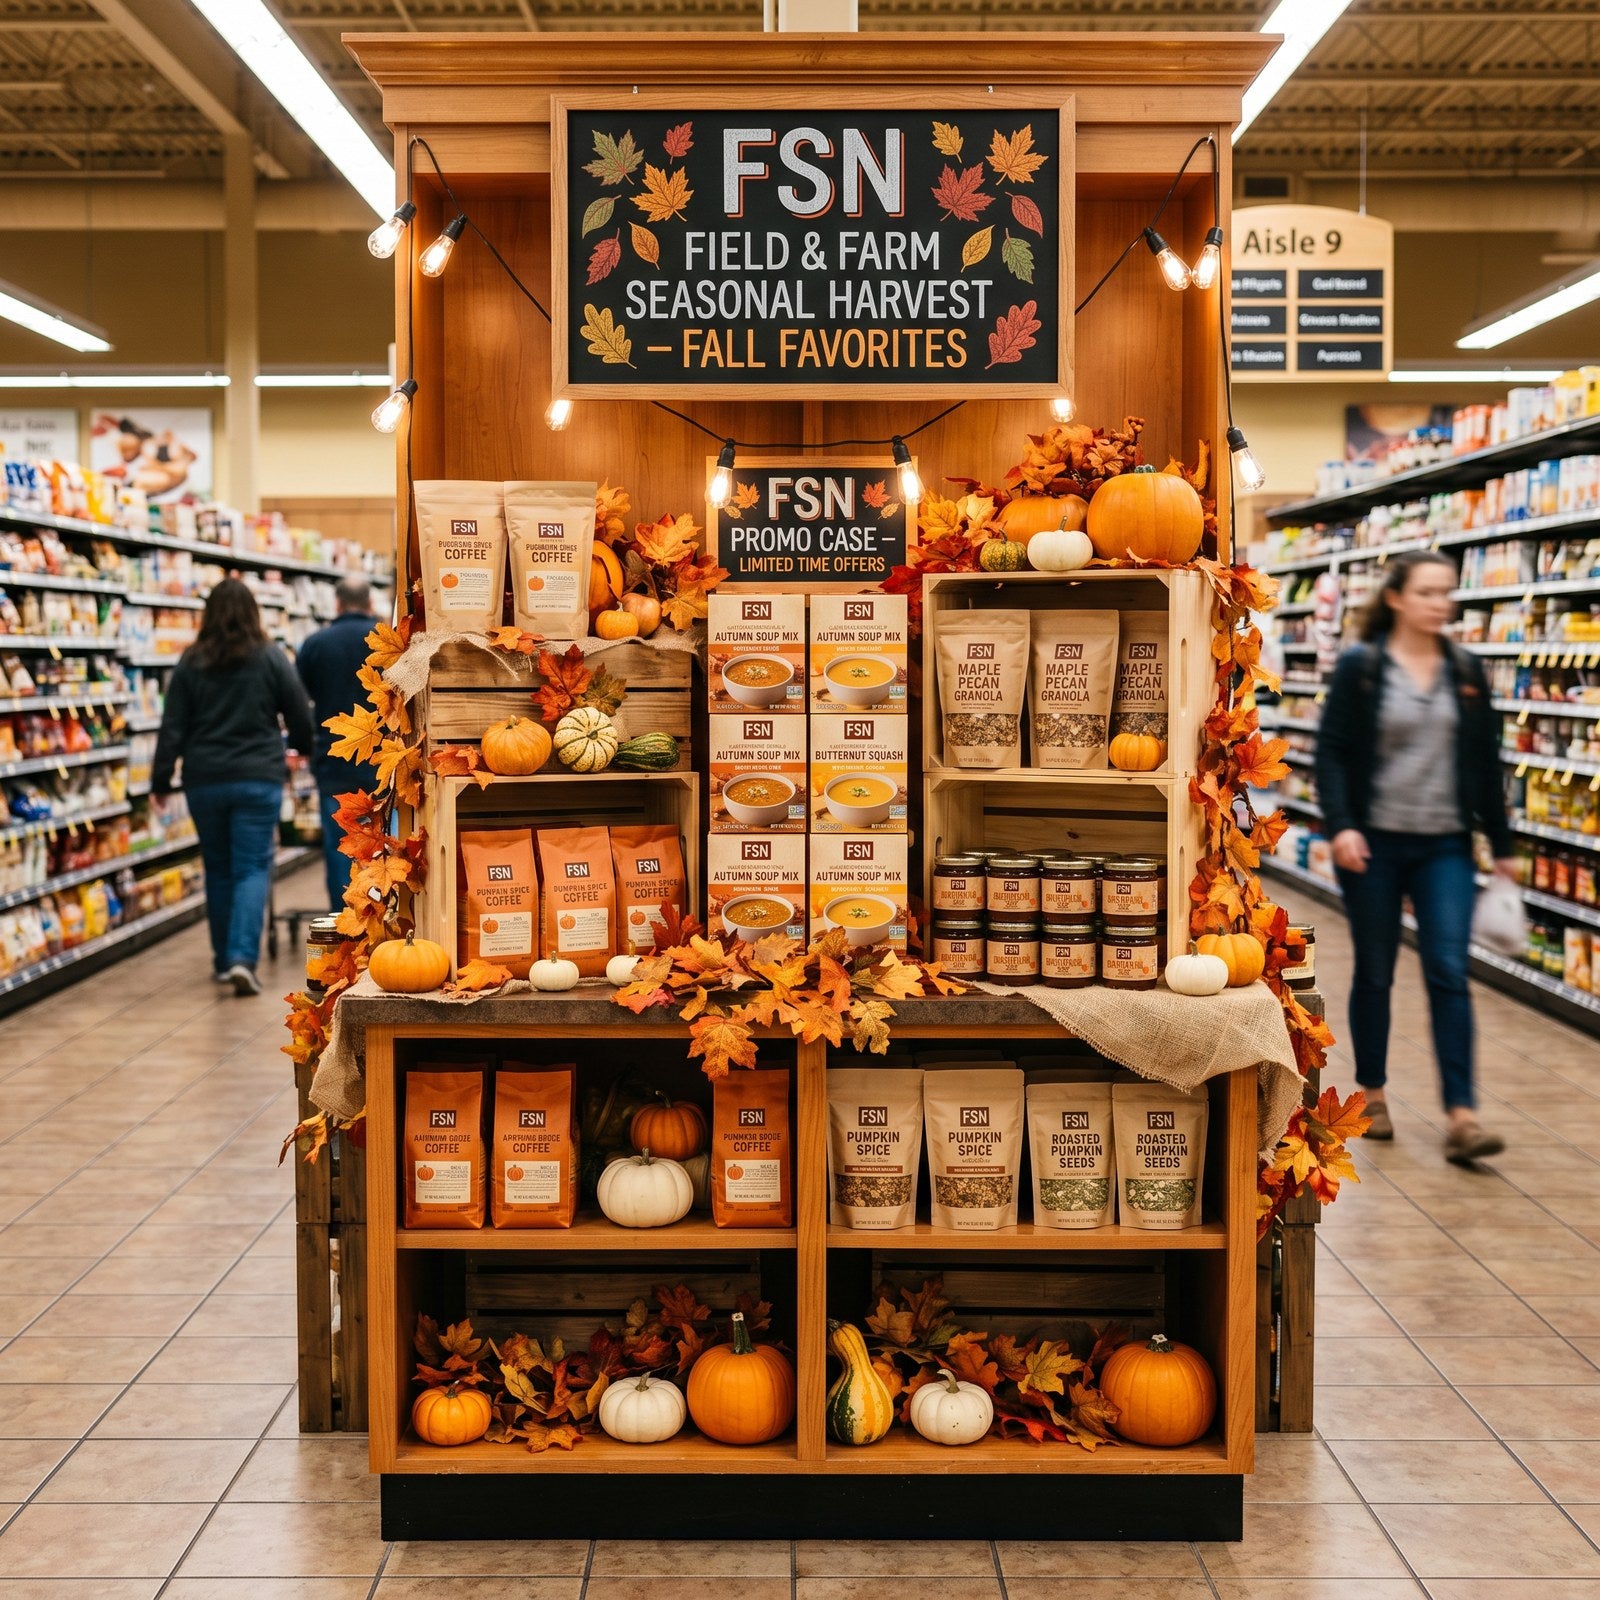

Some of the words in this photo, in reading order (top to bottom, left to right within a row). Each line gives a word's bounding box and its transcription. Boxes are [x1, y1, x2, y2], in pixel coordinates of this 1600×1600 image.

[723, 127, 904, 218] FSN
[1243, 228, 1315, 254] Aisle
[1326, 229, 1342, 254] 9
[685, 231, 790, 270] FIELD
[800, 231, 828, 271] &
[839, 231, 940, 270] FARM
[625, 280, 816, 320] SEASONAL
[829, 280, 993, 320] HARVEST
[683, 328, 766, 368] FALL
[779, 328, 968, 368] FAVORITES
[768, 476, 856, 521] FSN
[453, 522, 477, 533] FSN
[540, 525, 563, 536] FSN
[731, 526, 811, 552] PROMO
[819, 526, 878, 552] CASE
[444, 549, 487, 561] COFFEE
[531, 551, 574, 563] COFFEE
[739, 556, 795, 573] LIMITED
[797, 556, 831, 573] TIME
[833, 556, 886, 573] OFFERS
[744, 604, 770, 617] FSN
[846, 604, 872, 617] FSN
[715, 632, 754, 642] AUTUMN
[755, 632, 780, 642] SOUP
[782, 632, 799, 642] MIX
[816, 632, 855, 642] AUTUMN
[857, 632, 882, 642] SOUP
[884, 632, 901, 642] MIX
[969, 646, 993, 657] FSN
[1056, 646, 1081, 658] FSN
[1131, 646, 1155, 658] FSN
[957, 663, 1001, 676] MAPLE
[1045, 663, 1089, 676] MAPLE
[1119, 663, 1163, 676] MAPLE
[958, 676, 1000, 689] PECAN
[1045, 676, 1088, 689] PECAN
[1119, 676, 1162, 689] PECAN
[954, 690, 1003, 701] GRANOLA
[1041, 690, 1090, 702] GRANOLA
[1116, 690, 1165, 701] GRANOLA
[746, 723, 771, 737] FSN
[846, 723, 872, 737] FSN
[716, 750, 754, 761] AUTUMN
[756, 750, 781, 761] SOUP
[783, 750, 801, 761] MIX
[815, 750, 865, 761] BUTTERNUT
[868, 750, 904, 761] SQUASH
[744, 844, 770, 858] FSN
[846, 844, 872, 858] FSN
[566, 864, 588, 877] FSN
[637, 860, 659, 873] FSN
[489, 867, 512, 880] FSN
[713, 871, 752, 882] AUTUMN
[754, 871, 779, 882] SOUP
[782, 871, 799, 882] MIX
[815, 871, 854, 882] AUTUMN
[857, 871, 881, 882] SOUP
[884, 871, 901, 882] MIX
[586, 882, 608, 891] SPICE
[634, 887, 670, 899] COFFEE
[485, 895, 522, 907] COFFEE
[431, 1112, 455, 1125] FSN
[521, 1112, 544, 1125] FSN
[741, 1111, 764, 1124] FSN
[861, 1109, 886, 1123] FSN
[962, 1109, 988, 1124] FSN
[1064, 1114, 1088, 1127] FSN
[1149, 1114, 1173, 1127] FSN
[846, 1131, 900, 1143] PUMPKIN
[948, 1131, 1002, 1143] PUMPKIN
[1052, 1133, 1100, 1145] ROASTED
[1137, 1133, 1186, 1145] ROASTED
[512, 1142, 551, 1153] COFFEE
[733, 1141, 771, 1152] COFFEE
[856, 1144, 891, 1156] SPICE
[958, 1144, 993, 1156] SPICE
[1051, 1145, 1103, 1156] PUMPKIN
[1135, 1145, 1188, 1156] PUMPKIN
[1059, 1157, 1096, 1168] SEEDS
[1144, 1157, 1181, 1168] SEEDS
